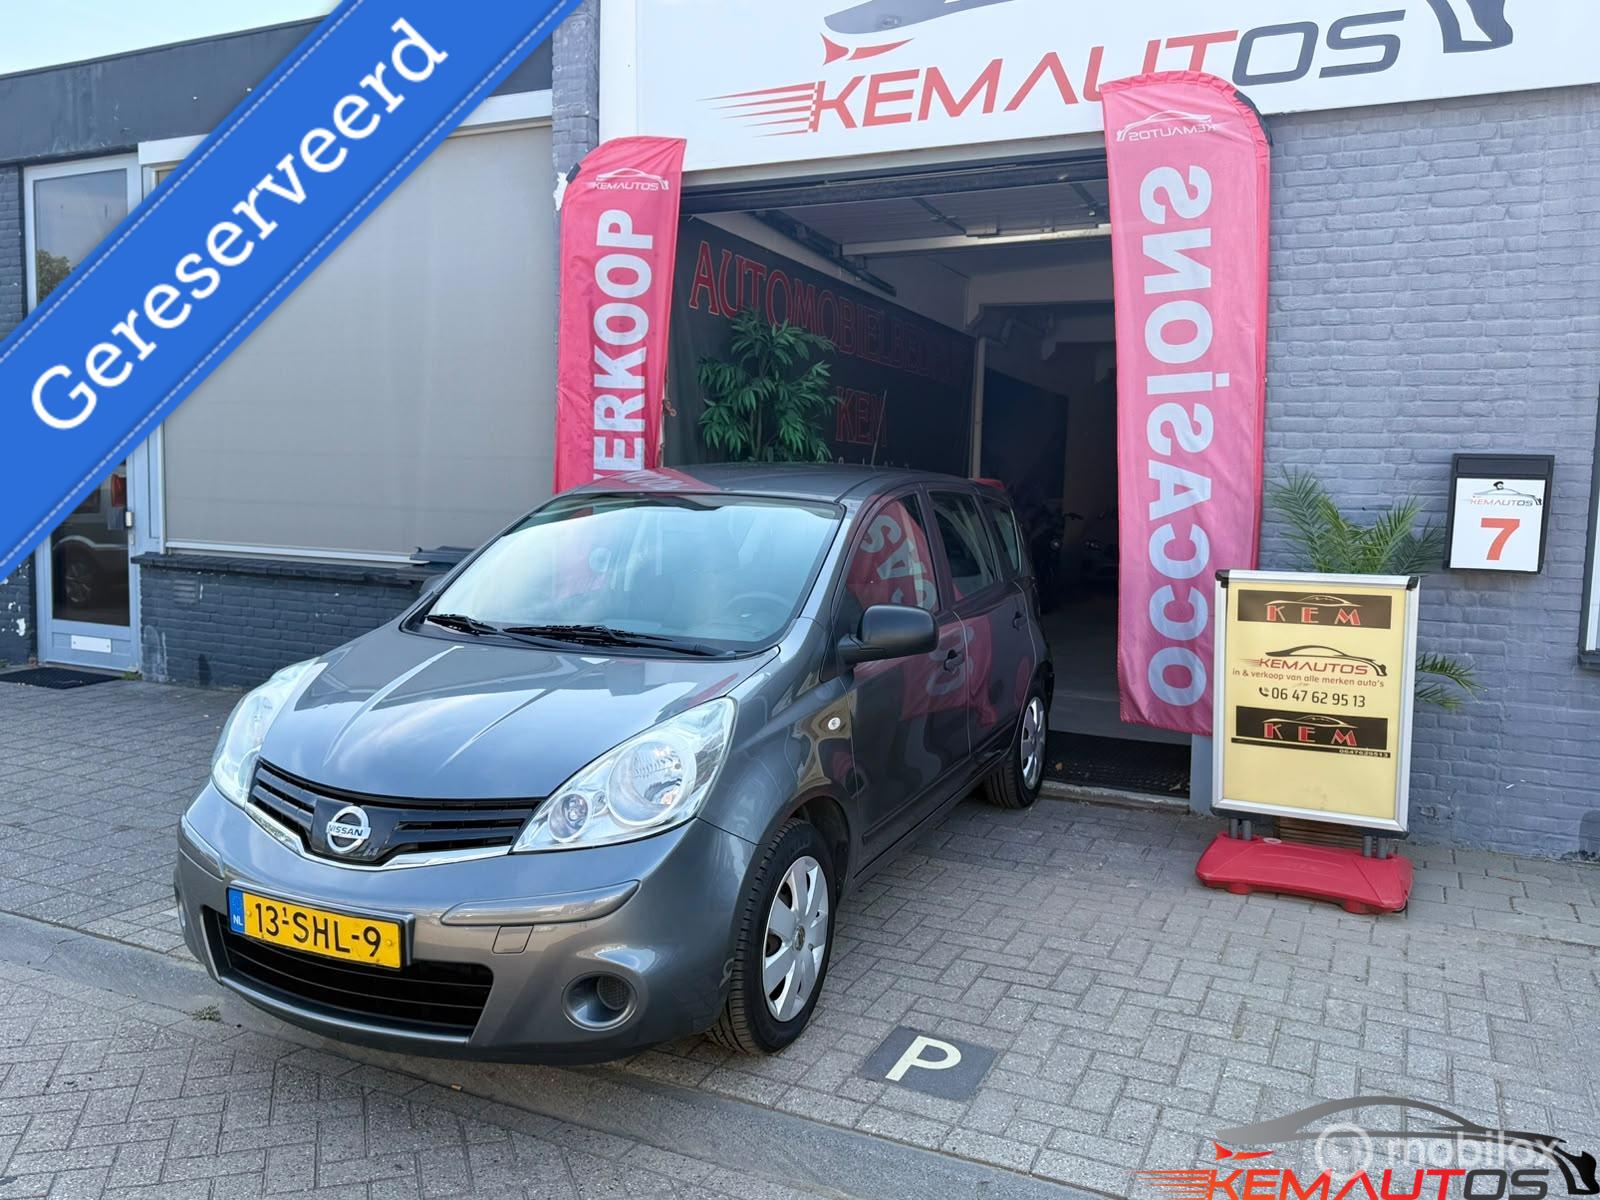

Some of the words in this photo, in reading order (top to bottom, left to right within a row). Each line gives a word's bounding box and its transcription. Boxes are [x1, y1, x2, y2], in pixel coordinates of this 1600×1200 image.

[810, 9, 1406, 134] KEMAUTOS
[592, 181, 659, 191] KEMAUTOS
[593, 209, 653, 481] ERKOOP
[1480, 517, 1520, 561] 7
[1266, 605, 1361, 626] KEM
[1259, 658, 1368, 675] KEMAUTOS
[1232, 668, 1240, 676] in
[1242, 669, 1249, 677] &
[1251, 671, 1284, 681] verkoop
[1304, 674, 1320, 683] alle
[1322, 677, 1354, 686] merken
[1357, 680, 1384, 688] auto's
[1271, 687, 1288, 700] 06
[1292, 689, 1307, 702] 47
[1311, 691, 1328, 704] 62
[1332, 693, 1348, 706] 95
[1353, 695, 1365, 708] 13
[1264, 723, 1357, 746] KEM
[327, 824, 363, 837] NISSAN
[233, 914, 243, 926] NL
[885, 1035, 962, 1082] P
